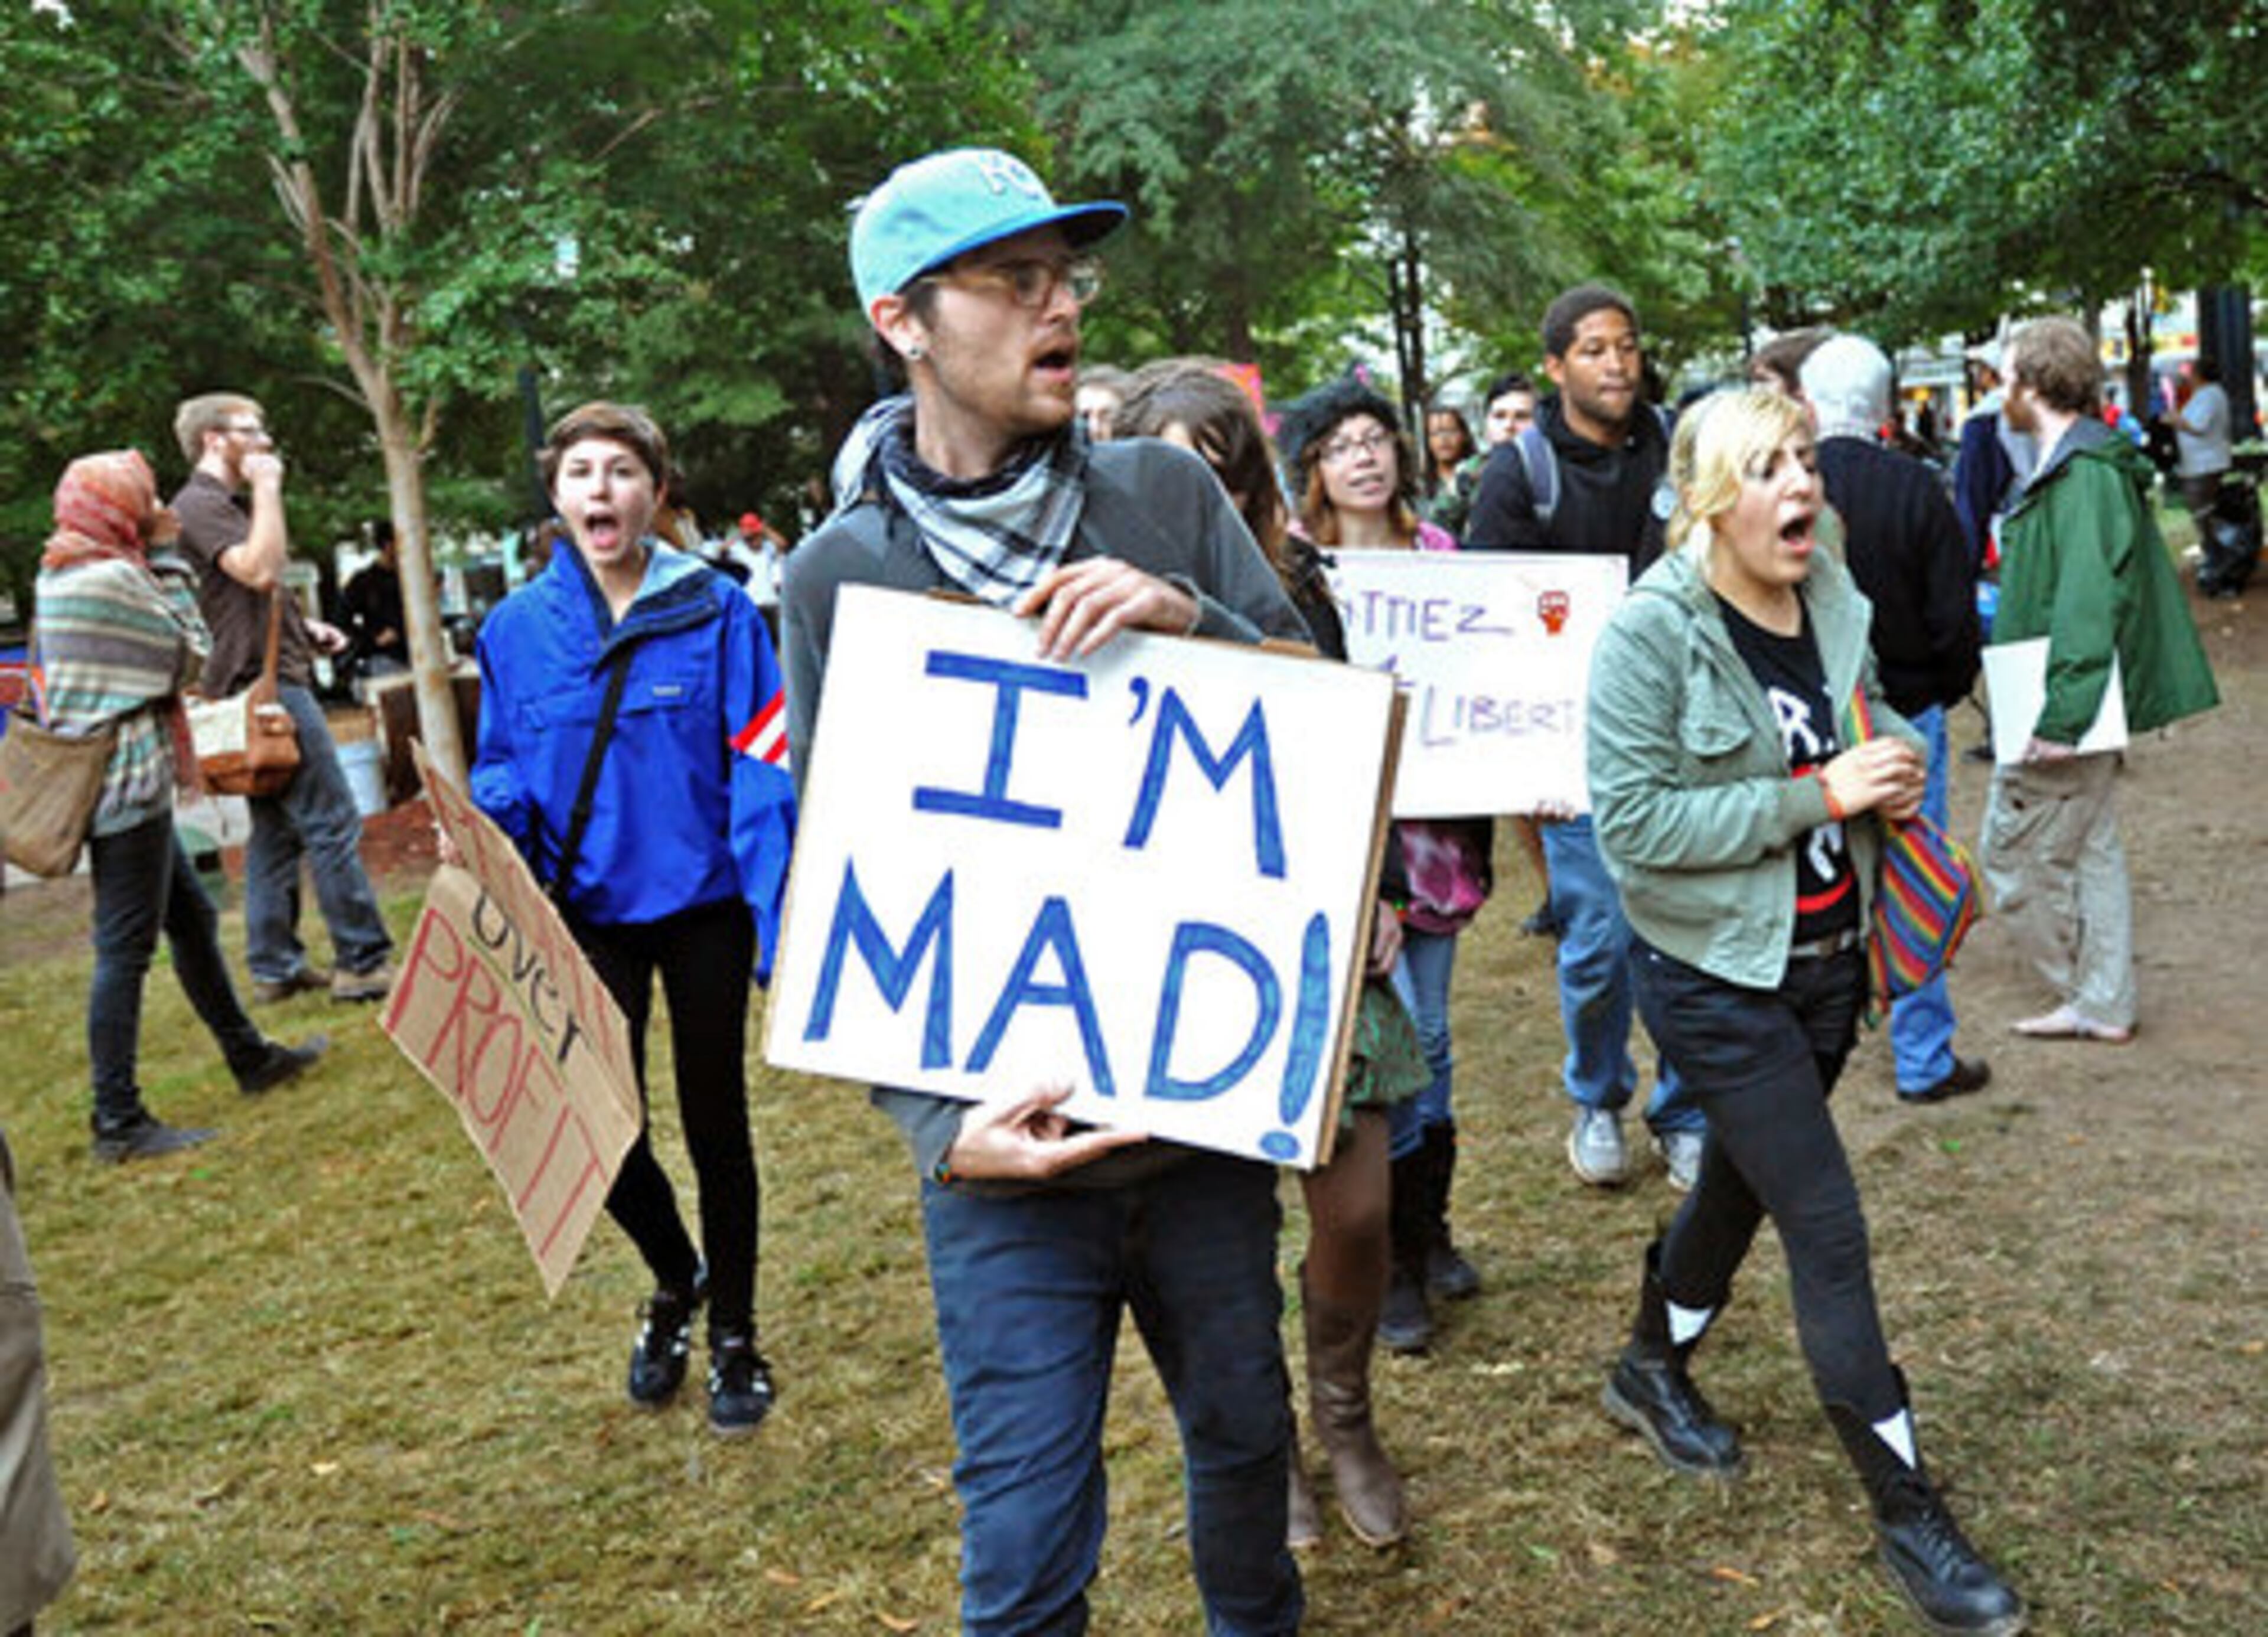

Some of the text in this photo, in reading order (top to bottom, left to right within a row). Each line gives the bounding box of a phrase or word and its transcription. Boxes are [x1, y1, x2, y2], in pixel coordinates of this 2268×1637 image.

[911, 649, 1288, 880] I'M
[1420, 684, 1576, 747] LIBERT
[1768, 685, 1836, 758] R
[384, 906, 609, 1259] PROFIT
[801, 855, 1331, 1162] MAD!
